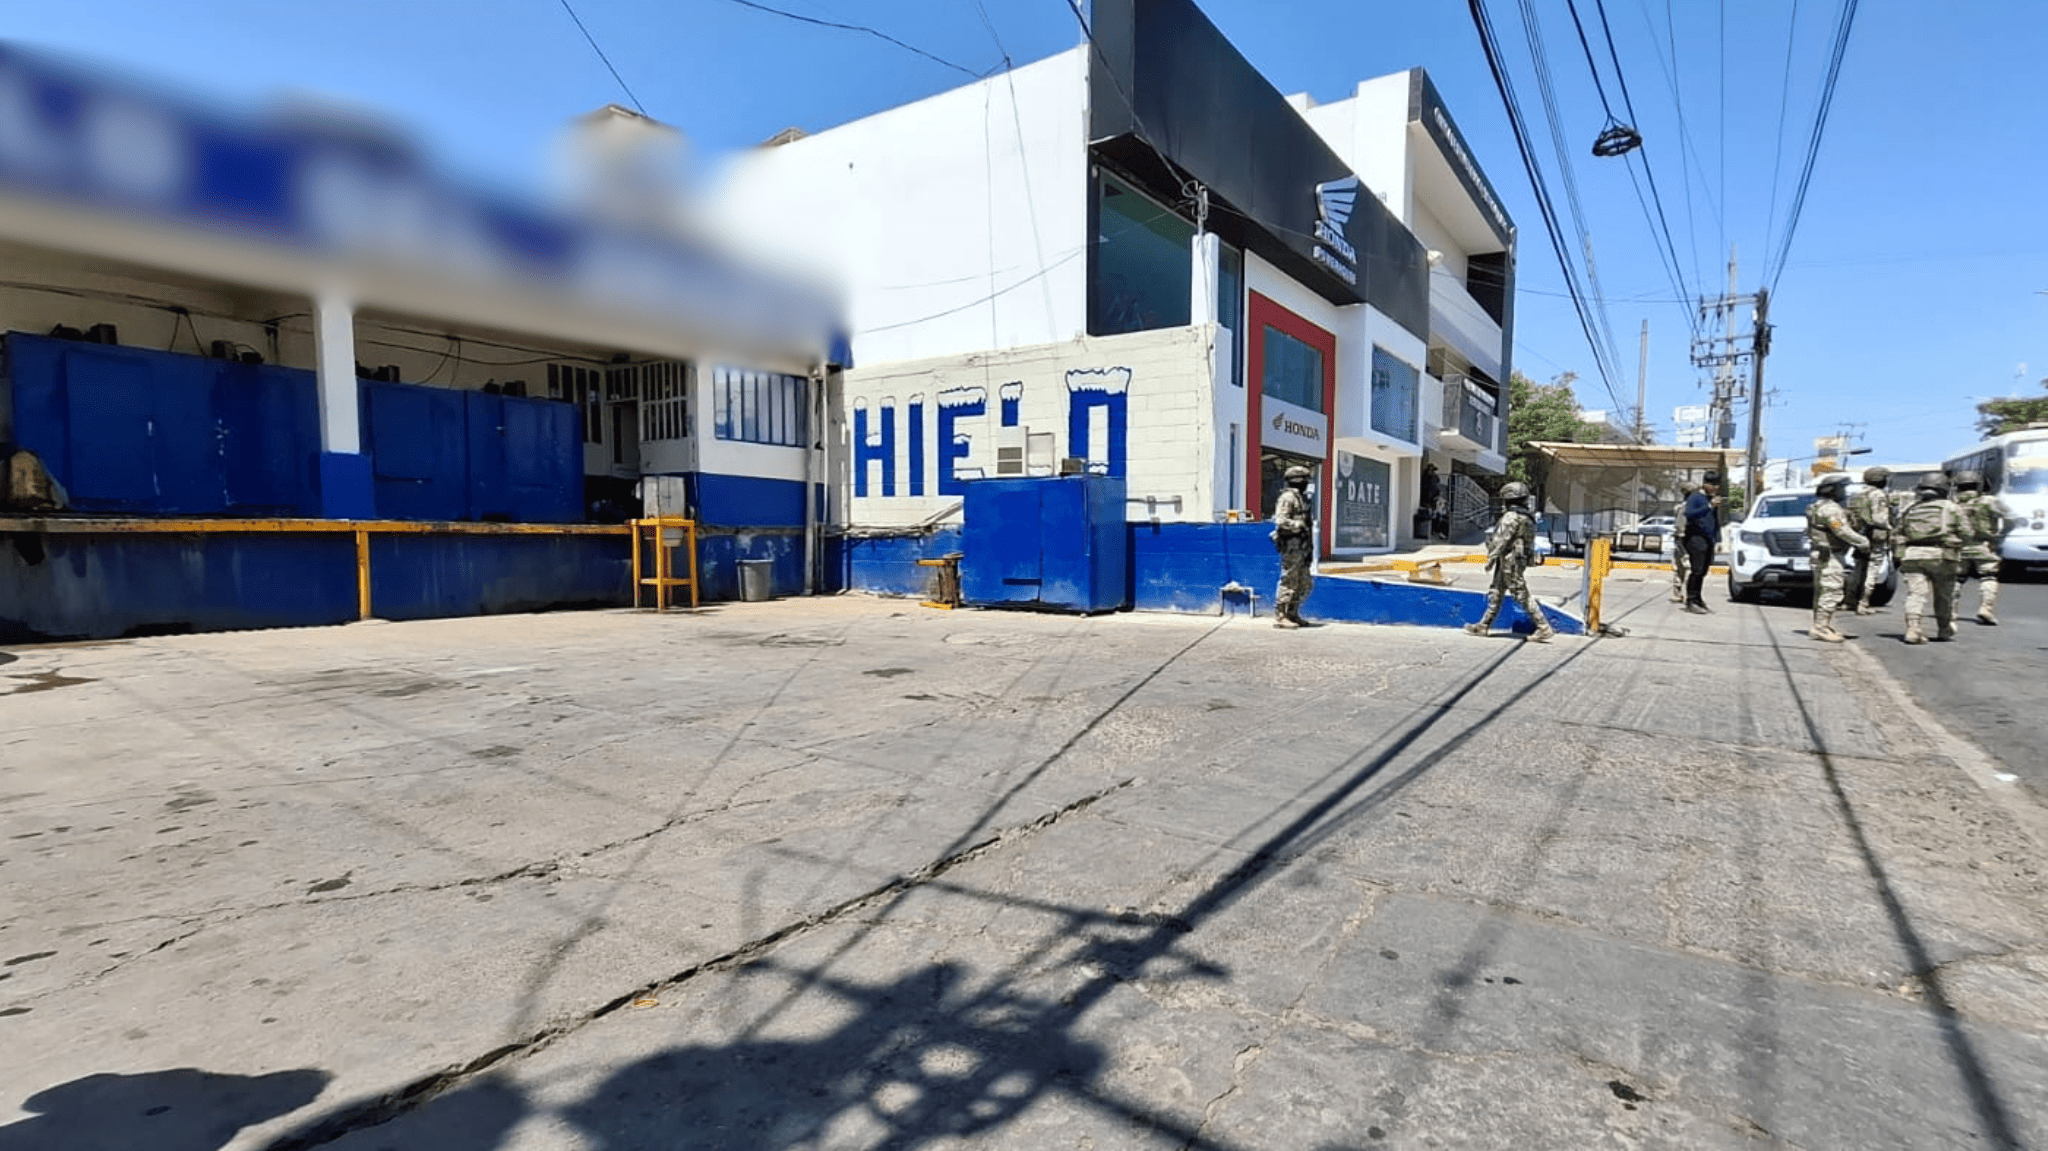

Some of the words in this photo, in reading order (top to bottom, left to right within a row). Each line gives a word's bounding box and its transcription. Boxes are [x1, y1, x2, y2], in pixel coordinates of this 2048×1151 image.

[1314, 220, 1357, 264] HONDA
[1284, 420, 1320, 440] HONDA
[1348, 480, 1380, 504] DATE
